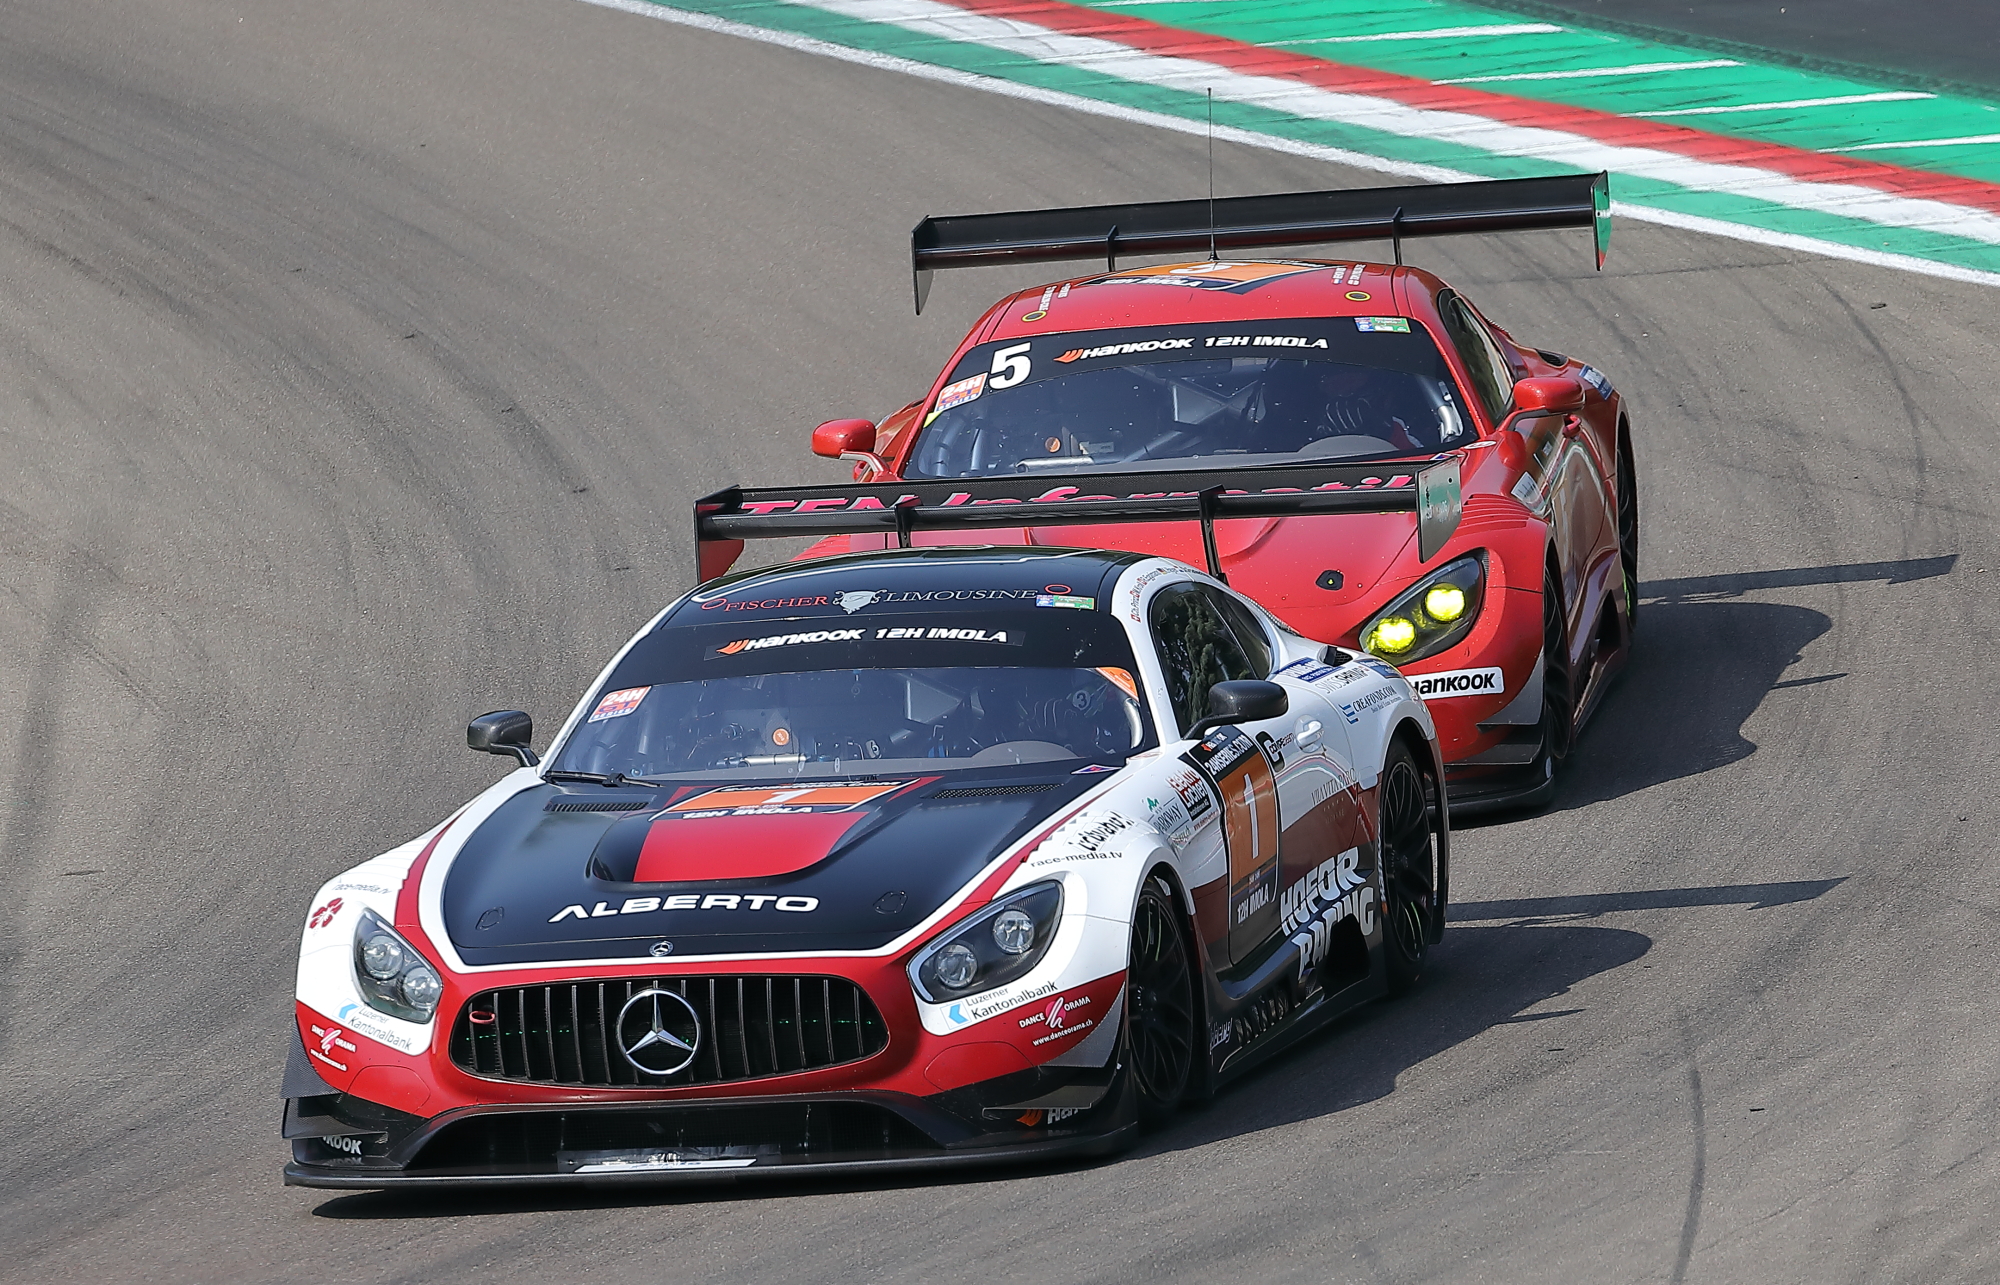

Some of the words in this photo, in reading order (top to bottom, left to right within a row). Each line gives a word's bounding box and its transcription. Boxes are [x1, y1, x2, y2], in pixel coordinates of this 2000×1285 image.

[1204, 336, 1250, 348] 12H
[1252, 336, 1329, 349] IMOLA
[989, 342, 1032, 390] 5
[942, 375, 983, 399] 24H
[724, 596, 828, 611] FISCHER
[879, 588, 1038, 603] LIMOUSINE
[875, 627, 925, 640] 12H
[926, 627, 1008, 643] IMOLA
[602, 688, 645, 706] 24H
[1204, 734, 1254, 776] 24HSERIES.COM
[761, 788, 818, 804] 1
[1175, 779, 1208, 809] Locher
[730, 806, 812, 816] IMOLA
[1152, 803, 1184, 832] PARKWAY
[1243, 773, 1260, 860] 1
[1030, 851, 1124, 868] race-media.tv
[1236, 898, 1249, 924] 12H
[1249, 882, 1270, 916] IMOLA
[1281, 847, 1367, 937] HOFOR
[548, 894, 820, 923] ALBERTO
[965, 986, 1010, 1007] Luzerner
[970, 980, 1059, 1020] Kantonalbank
[1019, 1012, 1046, 1029] DANCE
[1063, 996, 1091, 1012] ORAMA
[334, 1037, 357, 1053] ORAMA
[348, 1015, 413, 1051] Kantonalbank
[1032, 1018, 1094, 1047] www.danceorama.ch
